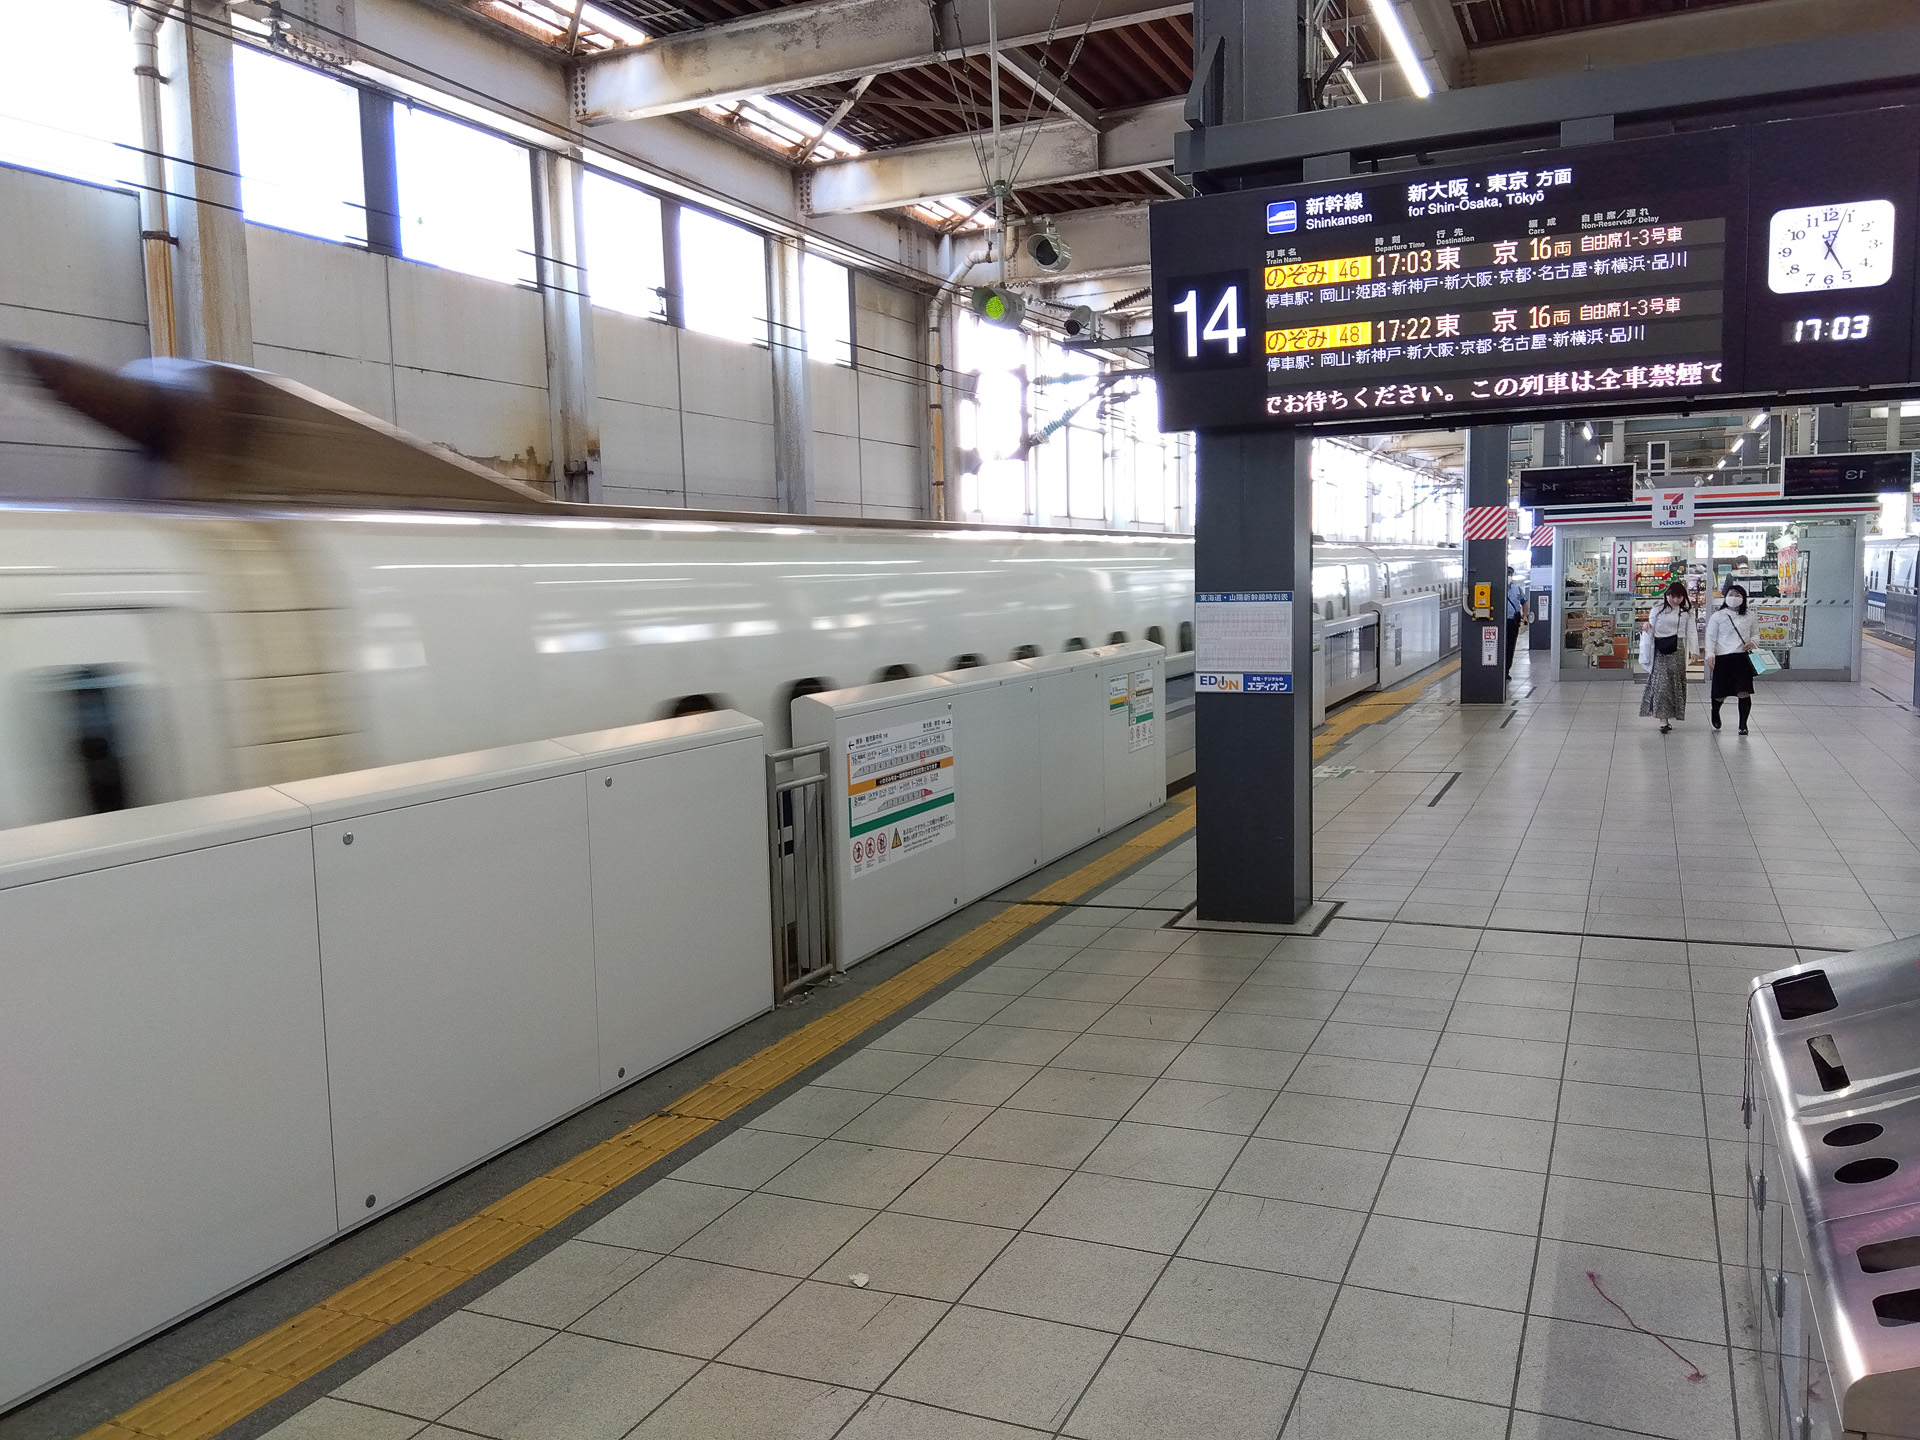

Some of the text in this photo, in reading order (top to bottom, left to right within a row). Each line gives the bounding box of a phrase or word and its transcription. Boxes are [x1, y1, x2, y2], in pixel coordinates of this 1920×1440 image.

[1536, 168, 1572, 188] 方面
[1306, 192, 1364, 216] 新幹線
[1408, 190, 1544, 217] for Shin-Ōsaka, Tōkyō
[1306, 214, 1372, 230] Shinkansen
[1375, 244, 1408, 253] Departure
[1436, 236, 1474, 246] Destination
[1266, 248, 1297, 258] 列車名
[1266, 264, 1327, 288] のぞみ
[1340, 260, 1359, 278] 46
[1377, 250, 1432, 277] 17:03
[1174, 286, 1246, 358] 14
[1795, 314, 1870, 342] 17:03
[1268, 328, 1328, 351] のぞみ
[1340, 326, 1360, 344] 48
[1377, 316, 1432, 343] 17:22
[1617, 544, 1628, 589] 入口専用
[1200, 676, 1239, 690] EDION
[1247, 682, 1288, 691] エディオン
